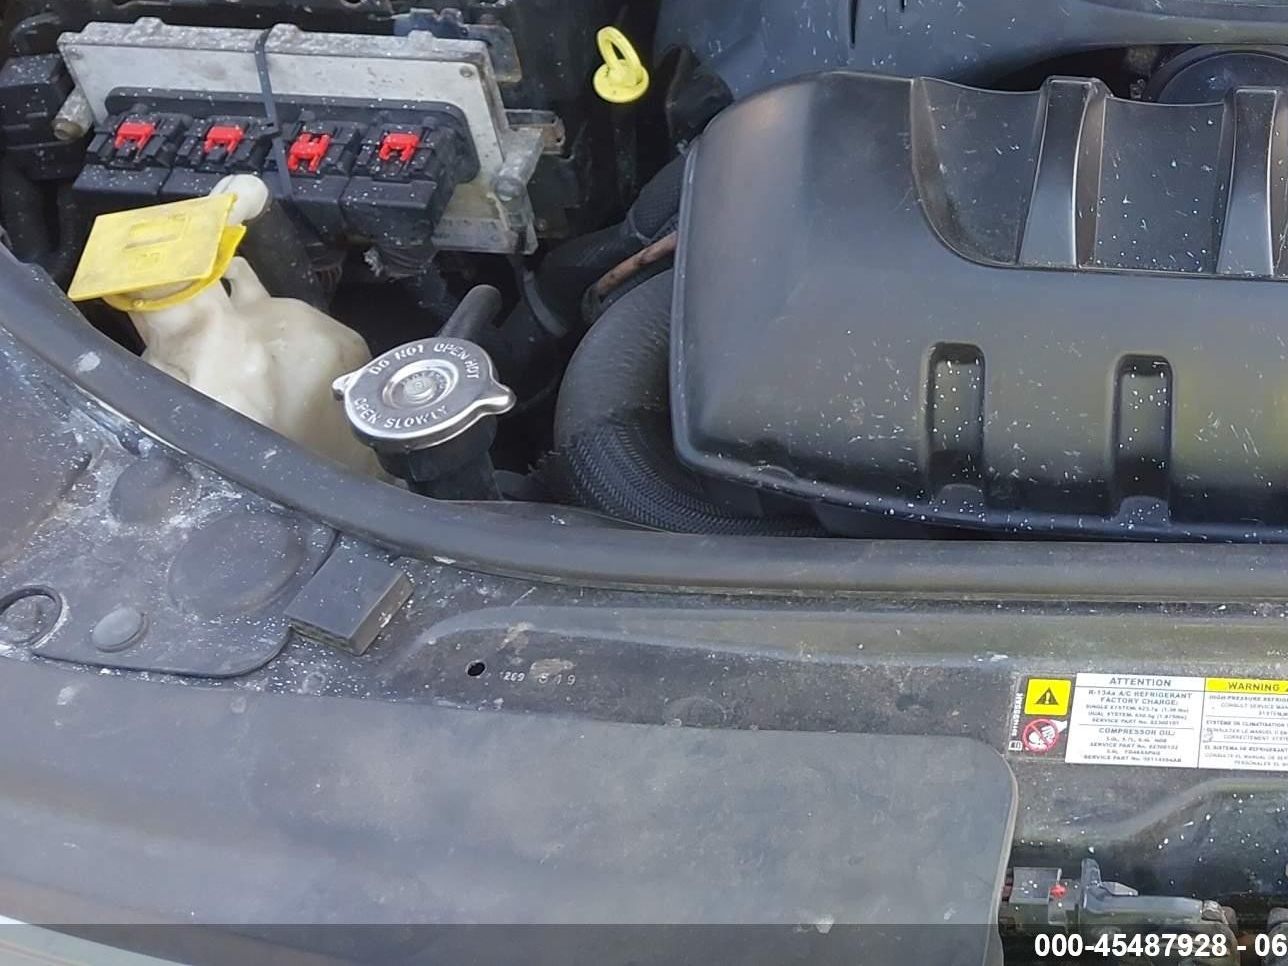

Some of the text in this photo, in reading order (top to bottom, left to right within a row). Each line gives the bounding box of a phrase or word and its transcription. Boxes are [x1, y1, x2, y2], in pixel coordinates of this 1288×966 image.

[369, 342, 480, 379] DO NOT OPEN HOT
[354, 397, 448, 429] OPEN SLOWLY
[1109, 677, 1171, 686] ATTENTION
[1227, 681, 1280, 691] WARNING
